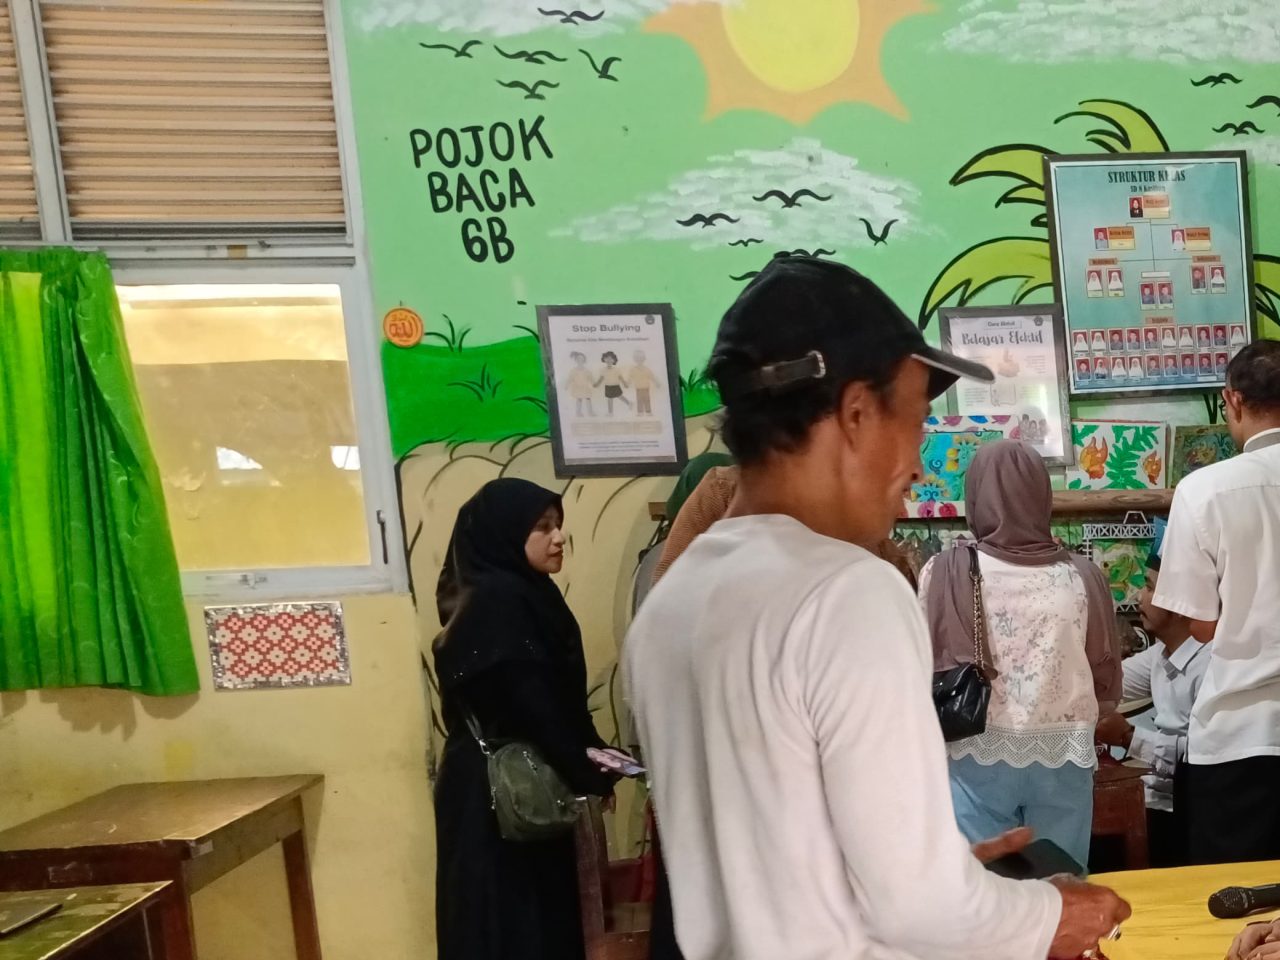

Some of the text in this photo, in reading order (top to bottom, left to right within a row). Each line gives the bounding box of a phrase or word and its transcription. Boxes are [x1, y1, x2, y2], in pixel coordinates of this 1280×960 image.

[410, 115, 553, 168] POJOK
[428, 168, 535, 213] BACA
[1108, 170, 1186, 183] STRUKTUR KAS
[461, 217, 514, 263] 6B
[572, 323, 641, 333] Stop Bullying
[962, 330, 1044, 347] Belajar Efektif
